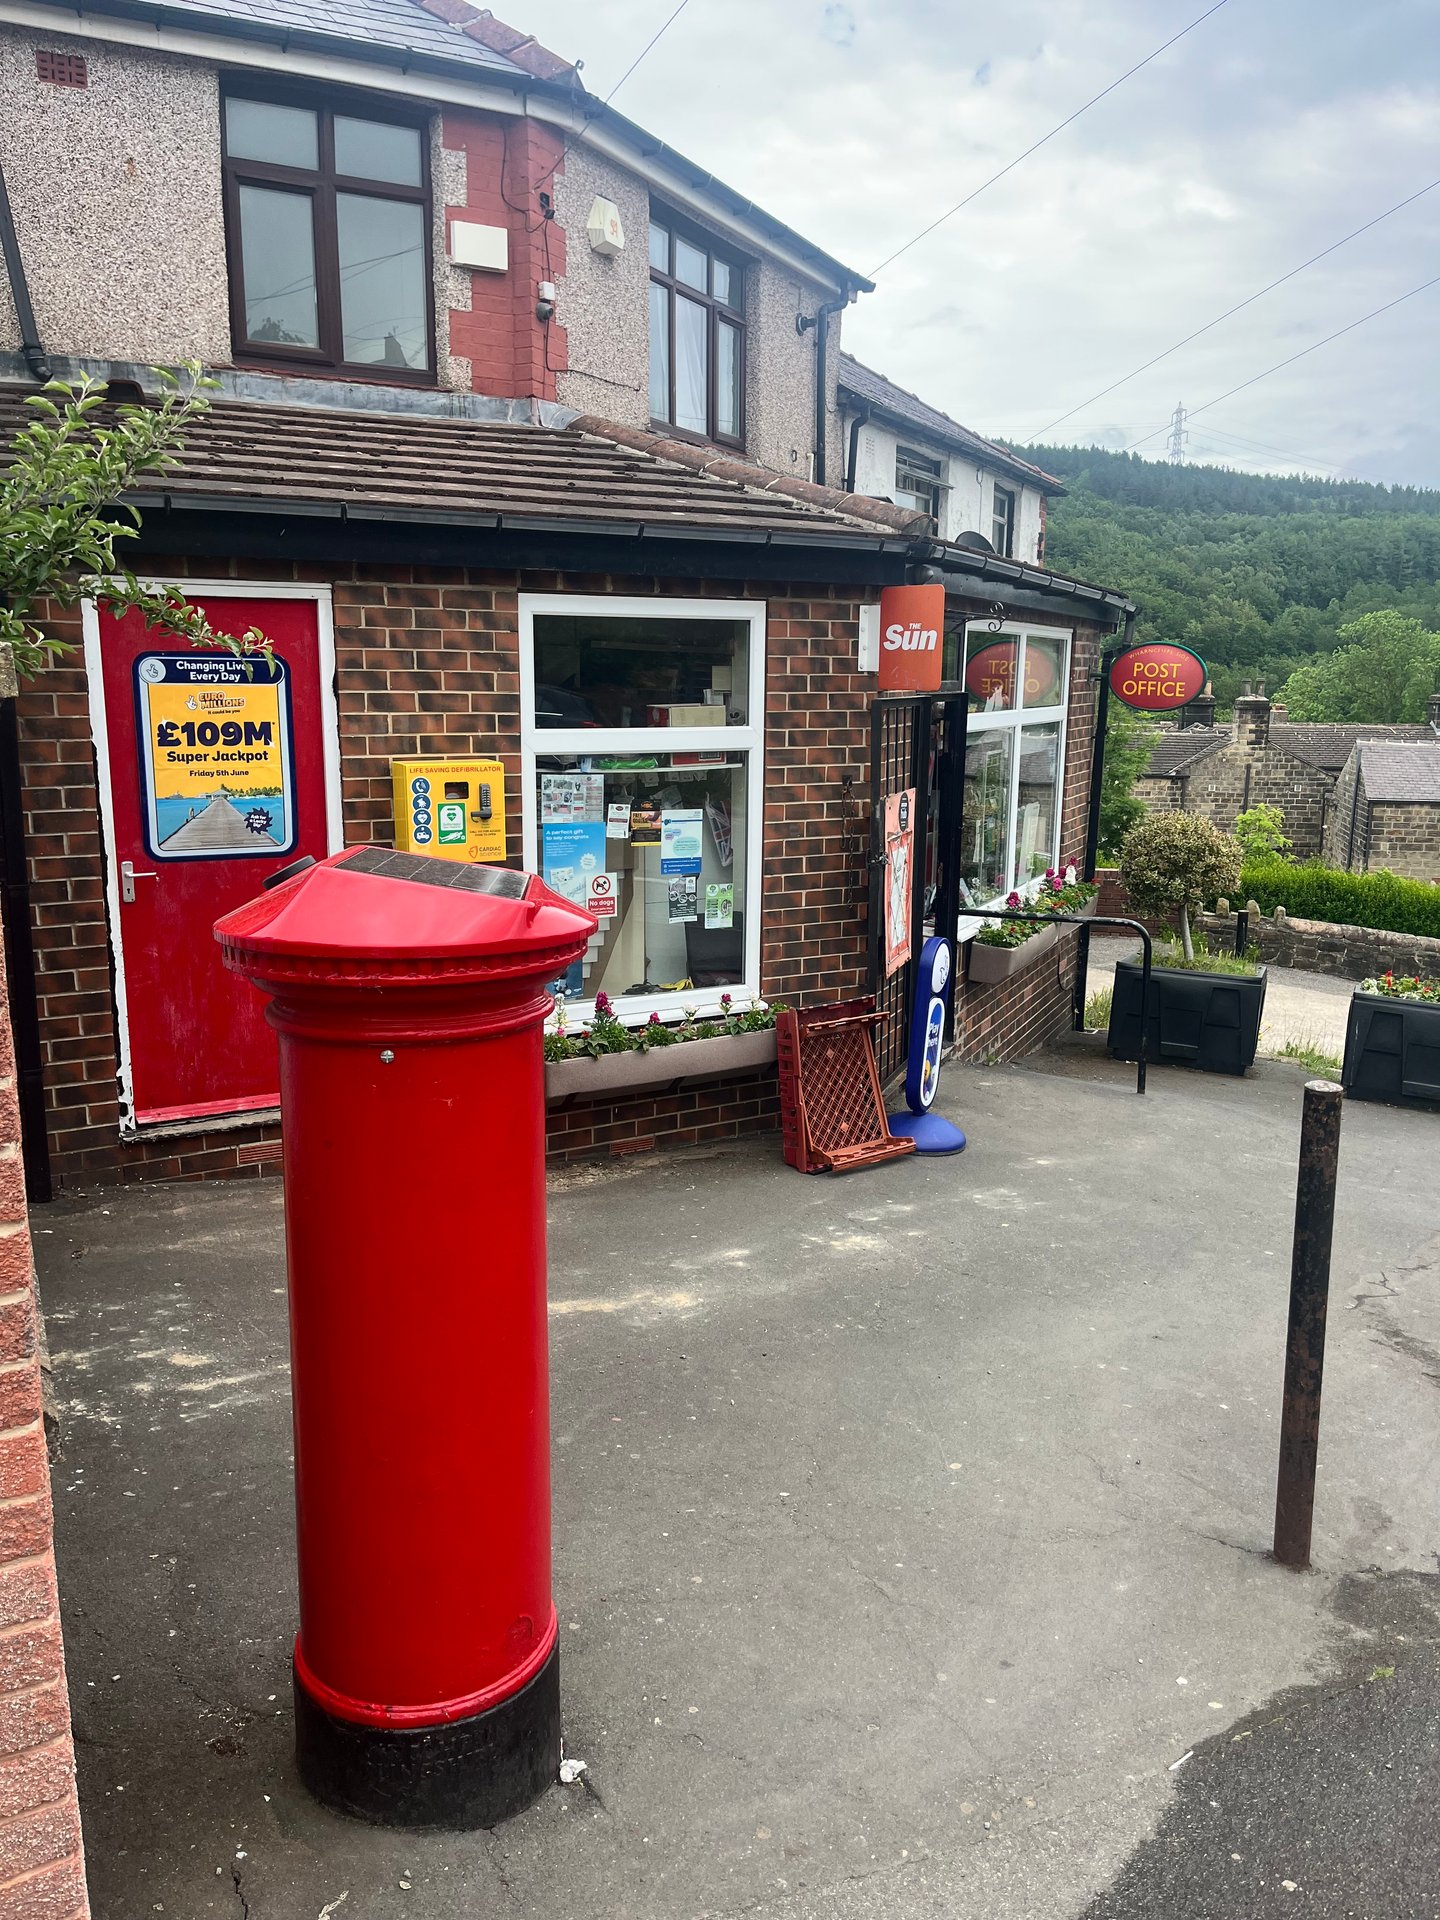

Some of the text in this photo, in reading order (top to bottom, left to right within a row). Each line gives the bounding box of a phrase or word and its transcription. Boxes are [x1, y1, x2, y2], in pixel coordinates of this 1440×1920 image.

[909, 622, 923, 630] THE
[883, 624, 938, 651] Sun
[176, 661, 225, 672] Changing
[1133, 662, 1182, 678] POST
[190, 672, 241, 683] Every Day
[1122, 680, 1186, 697] OFFICE
[199, 692, 225, 702] EURO
[201, 698, 245, 709] MILLIONS
[167, 749, 269, 765] Super Jackpot
[189, 769, 249, 778] Friday 5th June
[599, 899, 614, 907] dogs
[928, 1022, 940, 1036] Play
